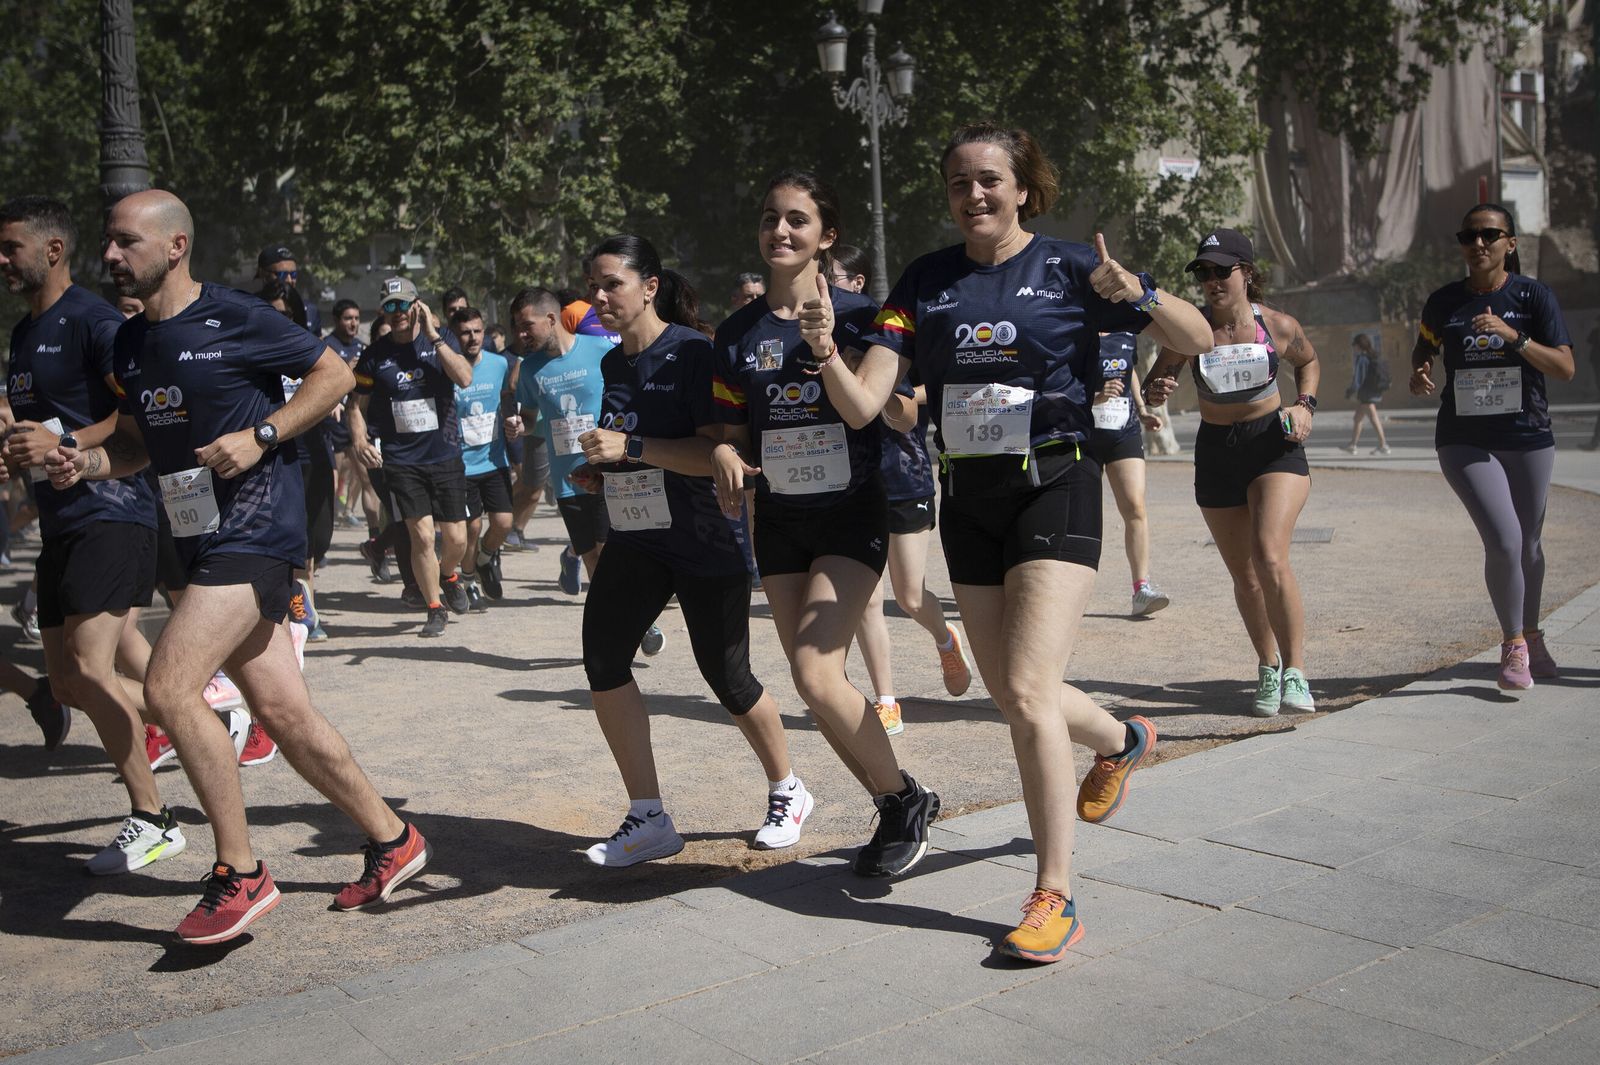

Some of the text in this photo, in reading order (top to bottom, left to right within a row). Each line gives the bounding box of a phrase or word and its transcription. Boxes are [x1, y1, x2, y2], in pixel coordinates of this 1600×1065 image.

[1036, 289, 1064, 300] mupol
[926, 301, 960, 313] Santander
[955, 320, 1017, 349] 200
[1462, 334, 1505, 352] 200
[195, 350, 222, 361] mupol
[955, 349, 1005, 359] POLICIA
[956, 355, 1019, 366] NACIONAL
[1222, 369, 1252, 384] 119
[140, 385, 183, 412] 200
[765, 381, 821, 405] 200
[1473, 394, 1504, 407] 335
[146, 410, 177, 420] POLICIA
[769, 413, 818, 421] NACIONAL
[1099, 414, 1118, 424] 507
[148, 417, 190, 427] NACIONAL
[966, 424, 1003, 442] 139
[787, 464, 826, 483] 258
[174, 508, 199, 526] 190
[622, 505, 650, 521] 191
